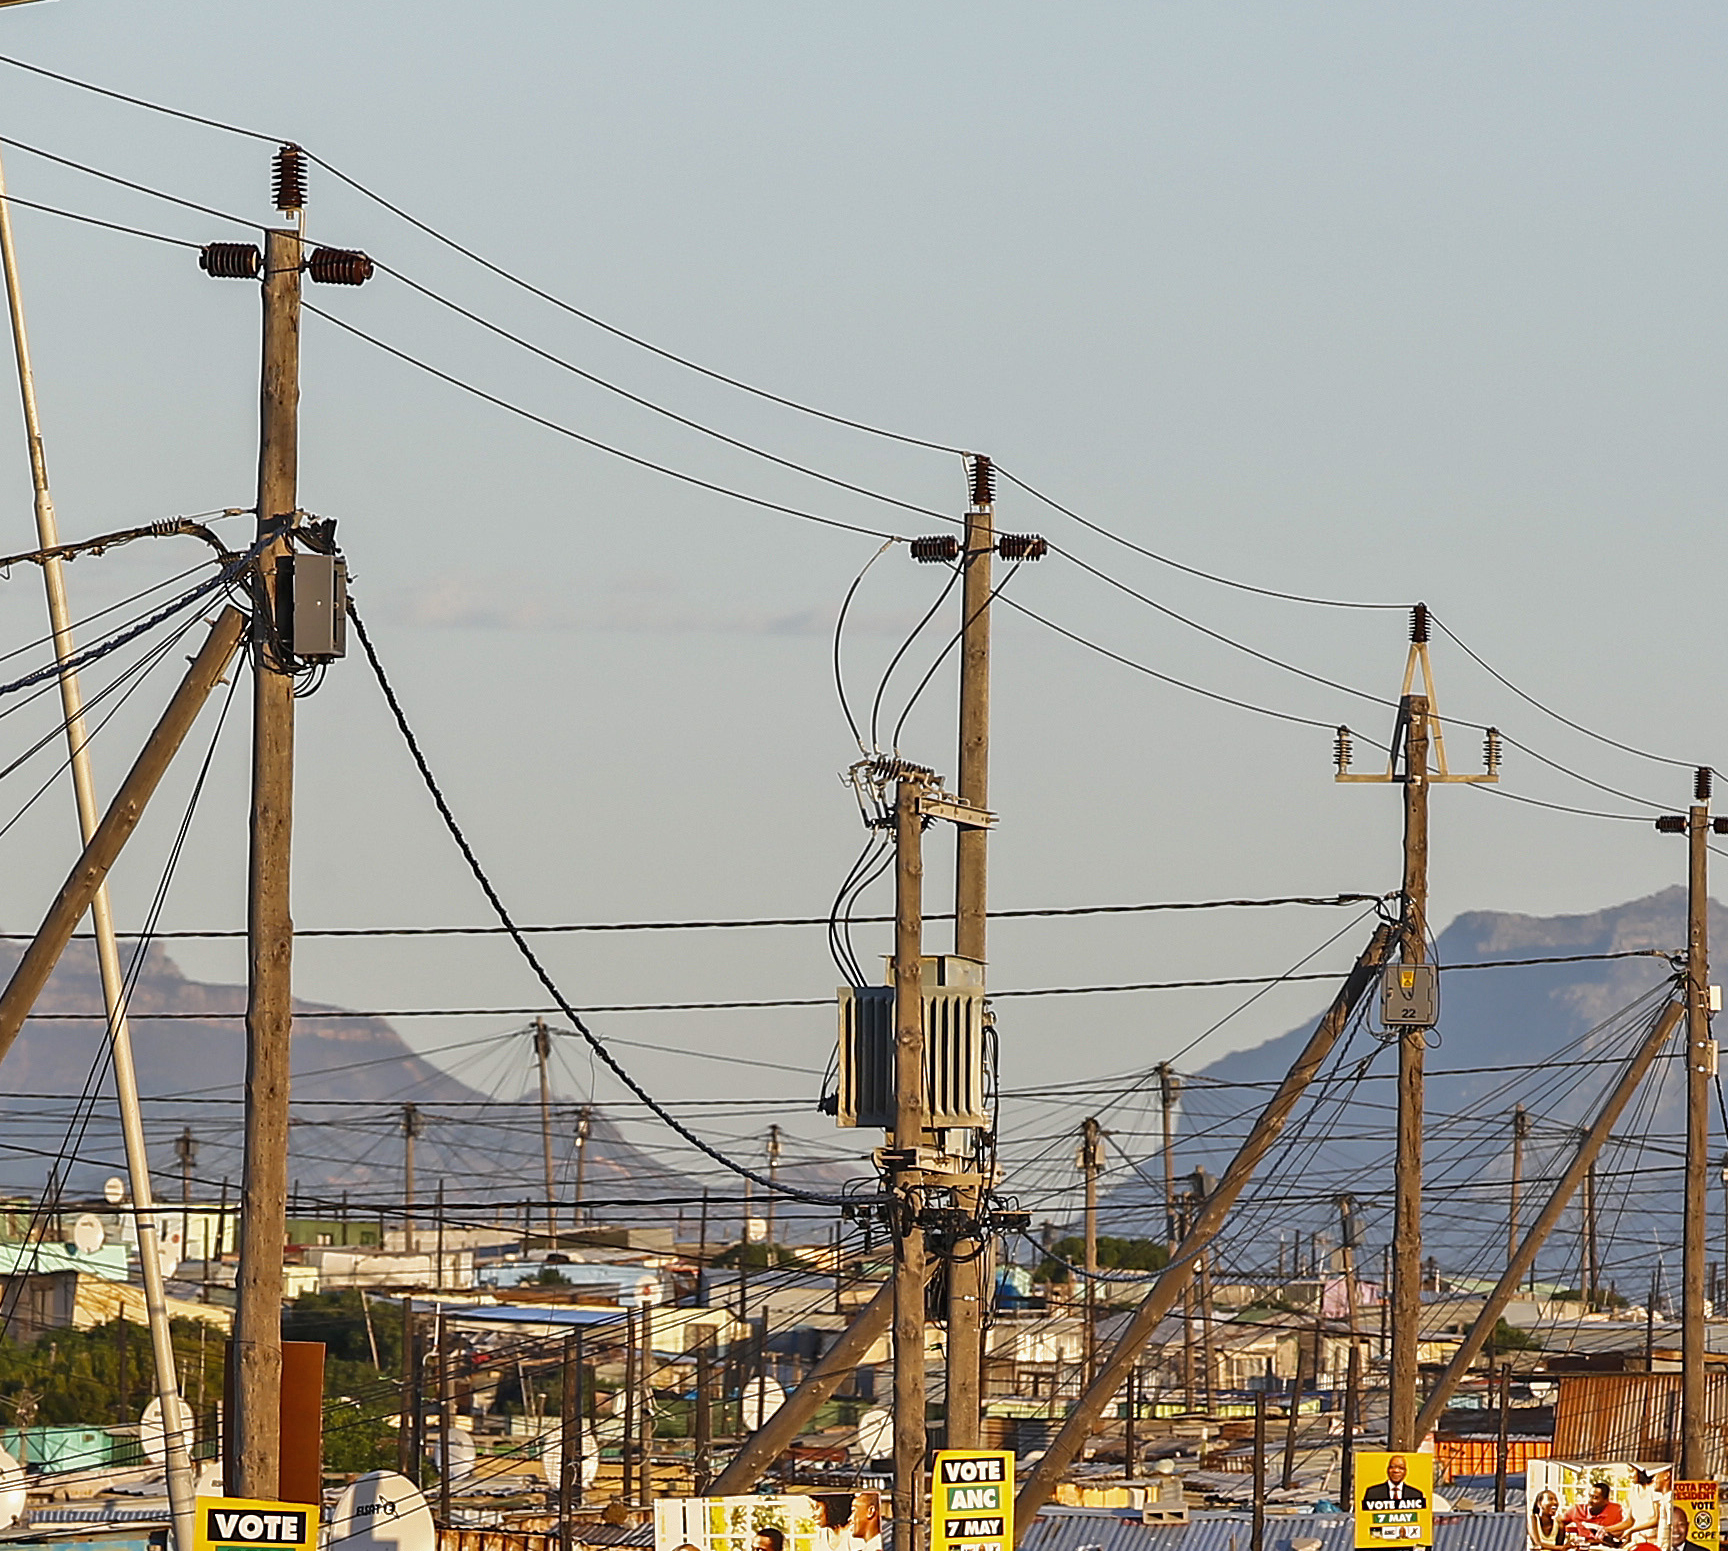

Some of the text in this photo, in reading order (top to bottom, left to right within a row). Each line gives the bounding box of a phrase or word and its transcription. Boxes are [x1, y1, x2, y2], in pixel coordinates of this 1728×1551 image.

[944, 1460, 1001, 1482] VOTE
[950, 1488, 996, 1509] ANC
[1366, 1499, 1423, 1510] VOTE ANC
[1691, 1501, 1715, 1510] VOTE
[1377, 1514, 1413, 1523] 7 MAY
[214, 1513, 299, 1541] VOTE
[947, 1520, 1001, 1537] 7 MAY
[1691, 1531, 1717, 1539] COPE
